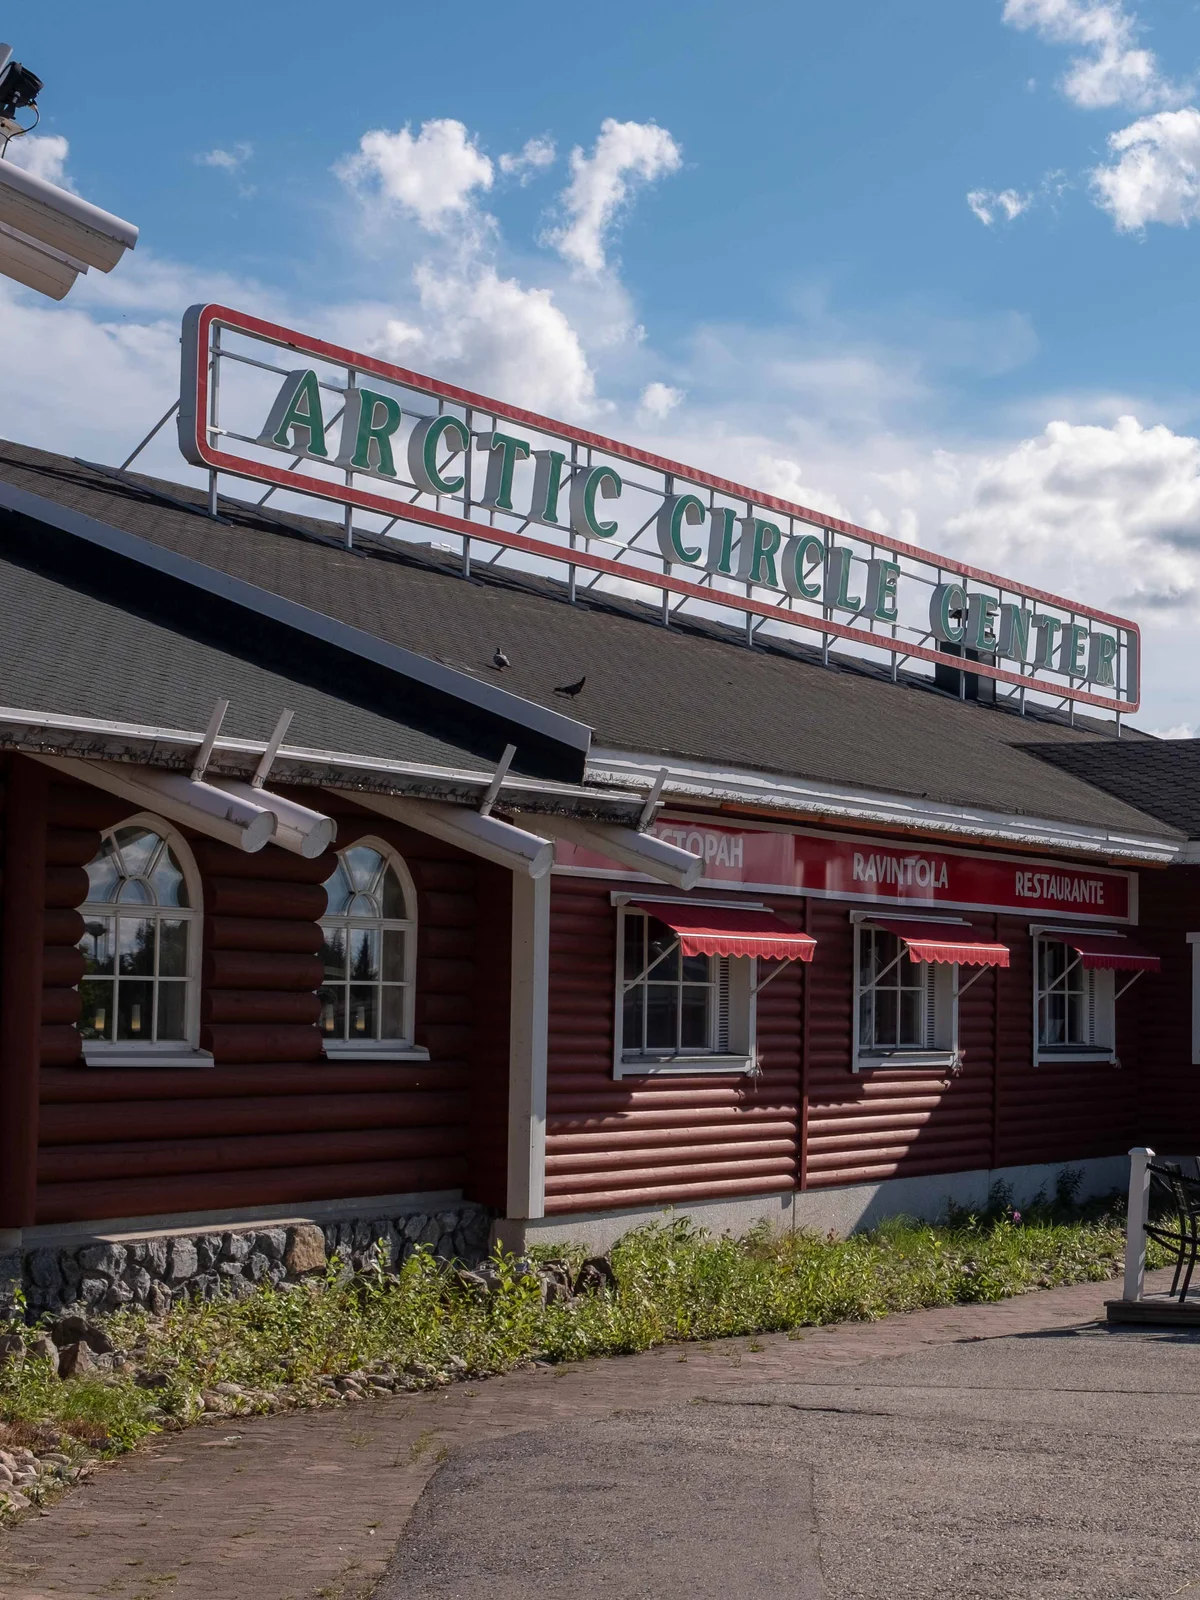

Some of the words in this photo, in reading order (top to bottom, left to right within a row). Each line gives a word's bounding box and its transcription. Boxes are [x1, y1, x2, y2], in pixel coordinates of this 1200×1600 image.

[257, 367, 623, 540] ARCTIC
[657, 493, 901, 624] CIRCLE
[930, 582, 1117, 687] CENTER
[852, 851, 949, 890] RAVINTOLA
[1014, 870, 1105, 905] RESTAURANTE
